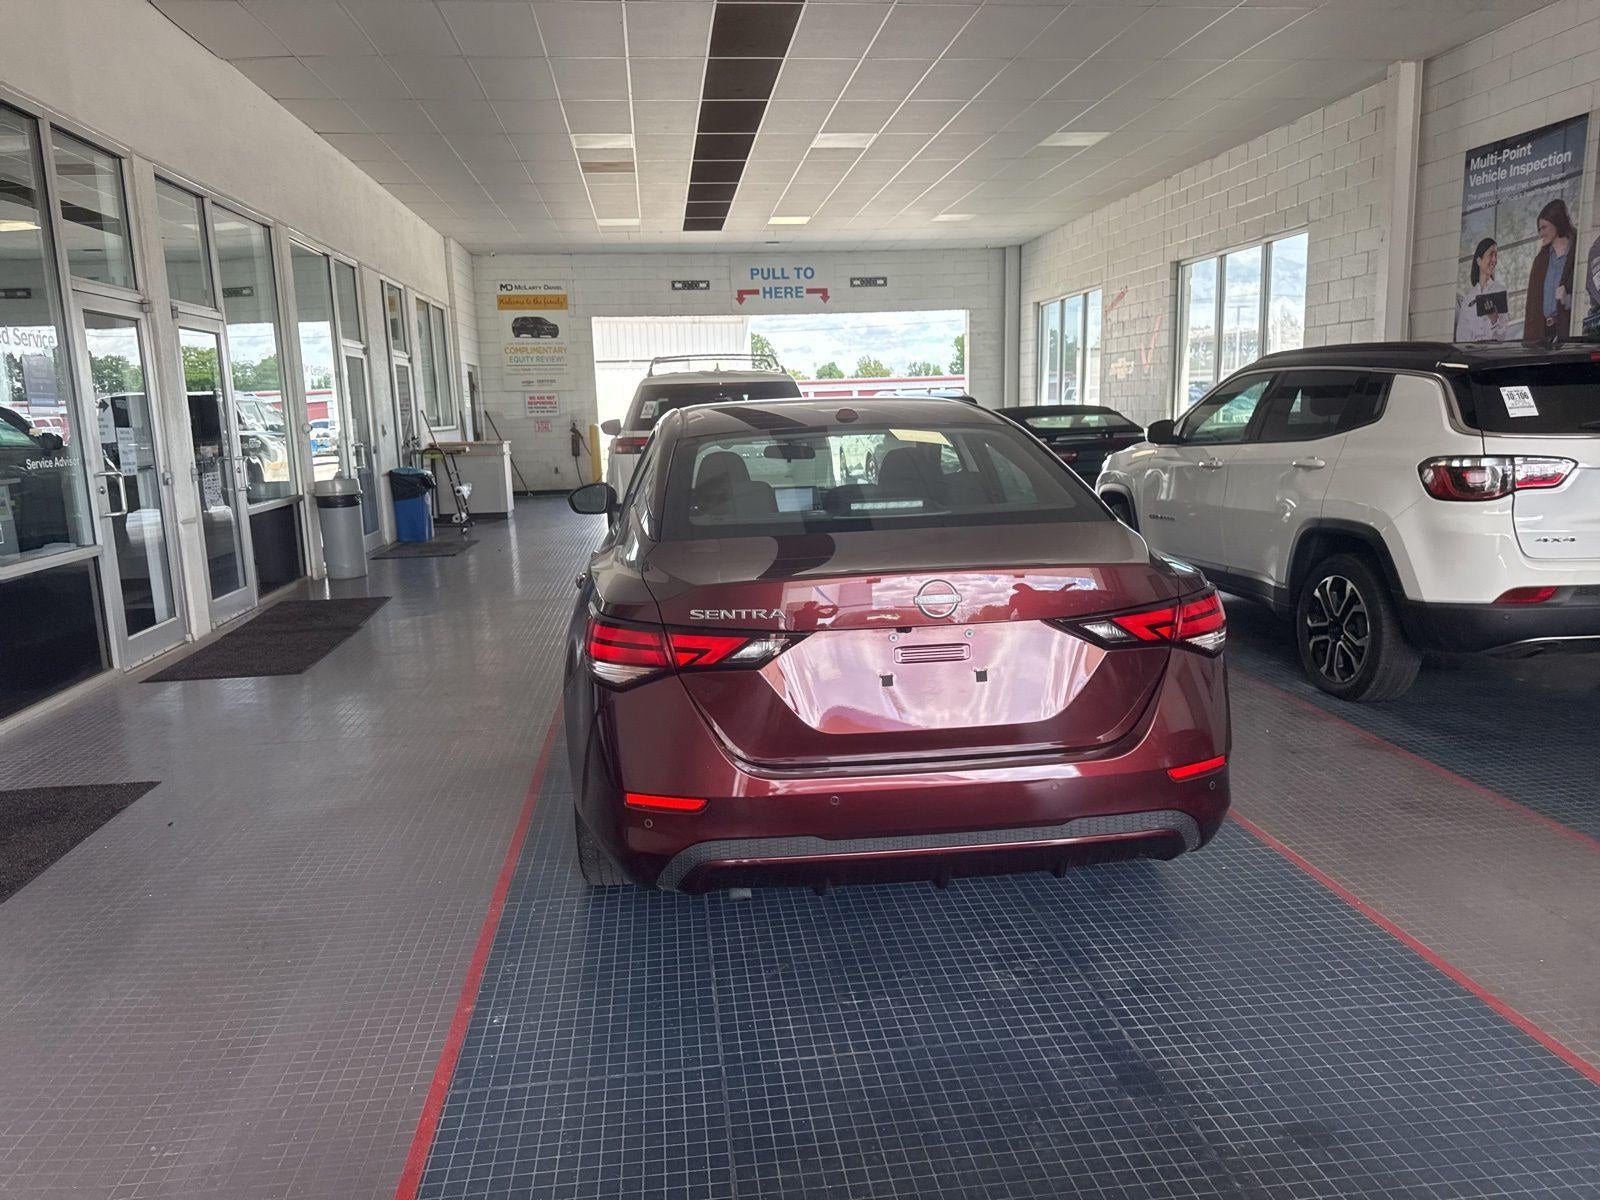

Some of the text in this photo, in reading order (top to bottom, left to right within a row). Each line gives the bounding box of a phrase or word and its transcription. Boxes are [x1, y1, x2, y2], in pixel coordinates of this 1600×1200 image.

[1470, 142, 1533, 171] Multi-Point
[1469, 151, 1572, 187] Vehicle Inspection
[750, 266, 815, 280] PULL TO
[763, 286, 804, 299] HERE
[13, 328, 55, 349] Service
[505, 346, 567, 354] COMPLIMENTARY
[26, 456, 80, 470] Service Advisor
[690, 608, 786, 620] SENTRA
